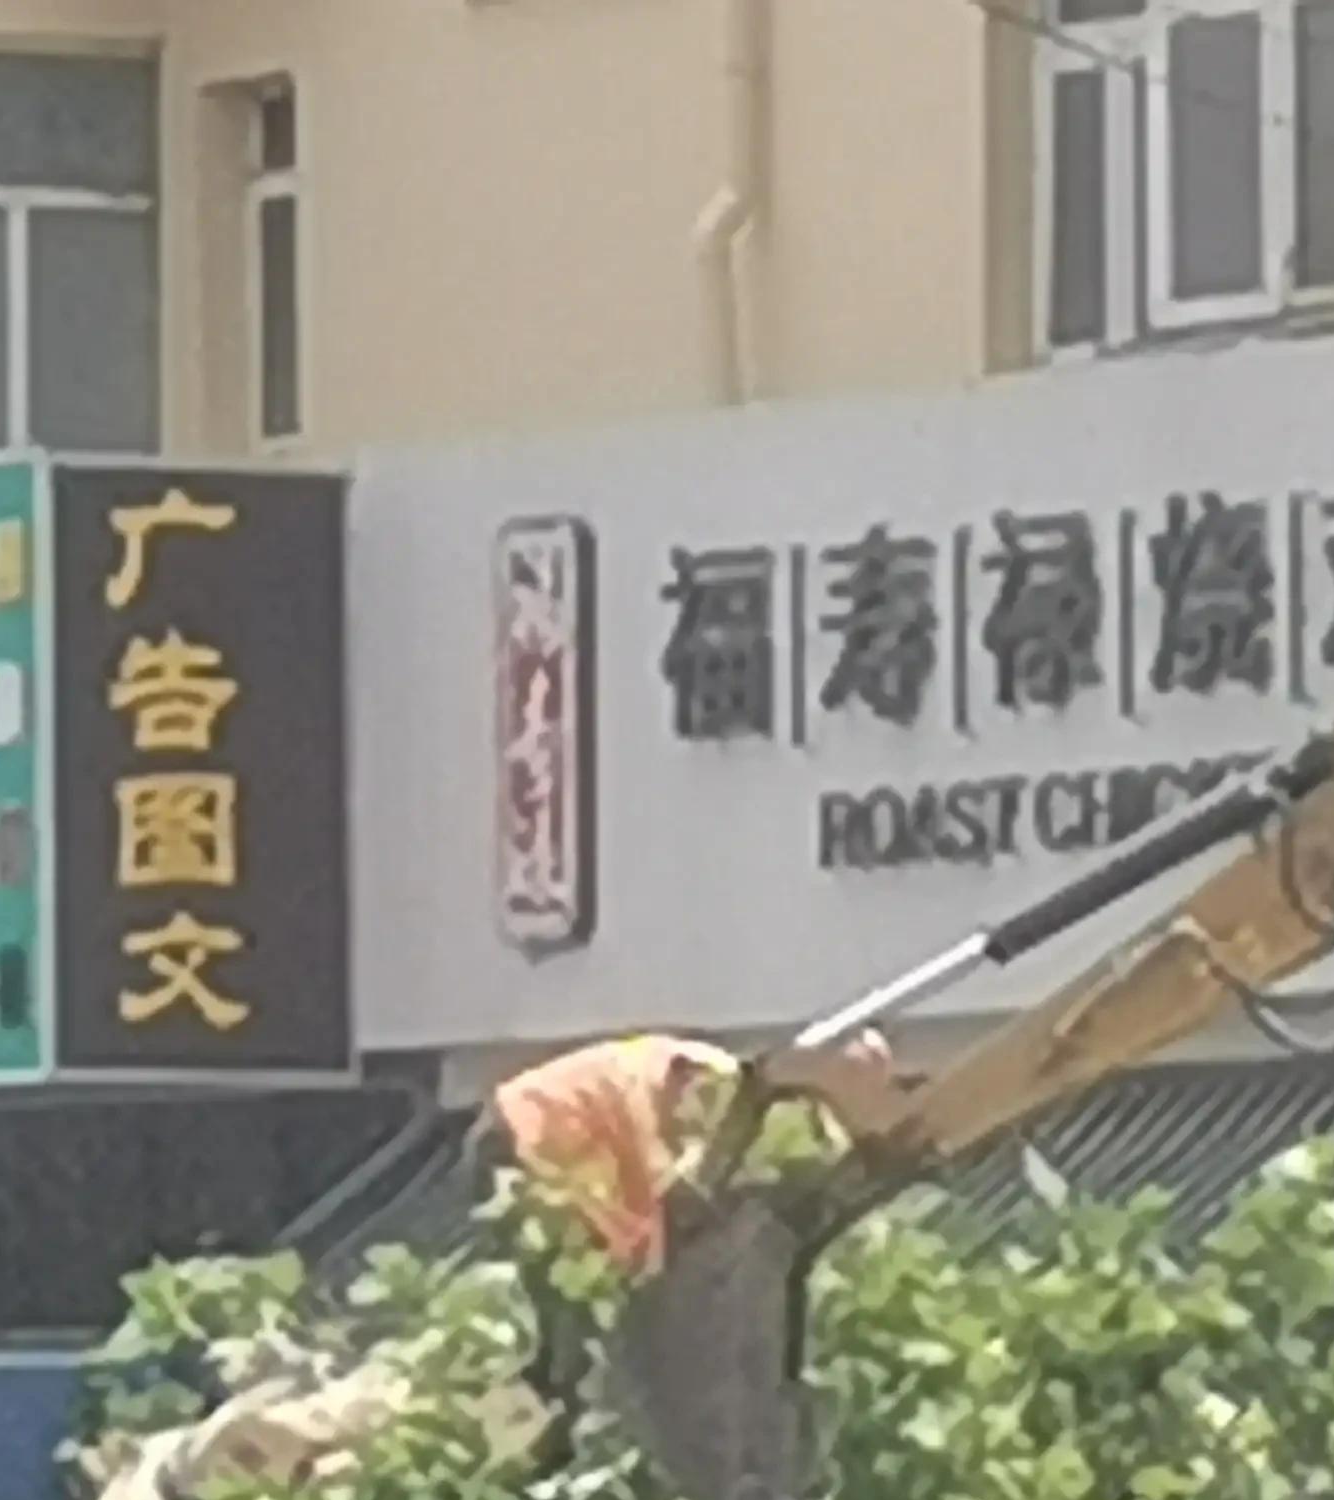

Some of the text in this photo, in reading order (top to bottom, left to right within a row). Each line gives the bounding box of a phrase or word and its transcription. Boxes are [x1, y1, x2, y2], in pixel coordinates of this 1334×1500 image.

[105, 488, 250, 1030] 广告图文
[818, 775, 1029, 869] ROAST
